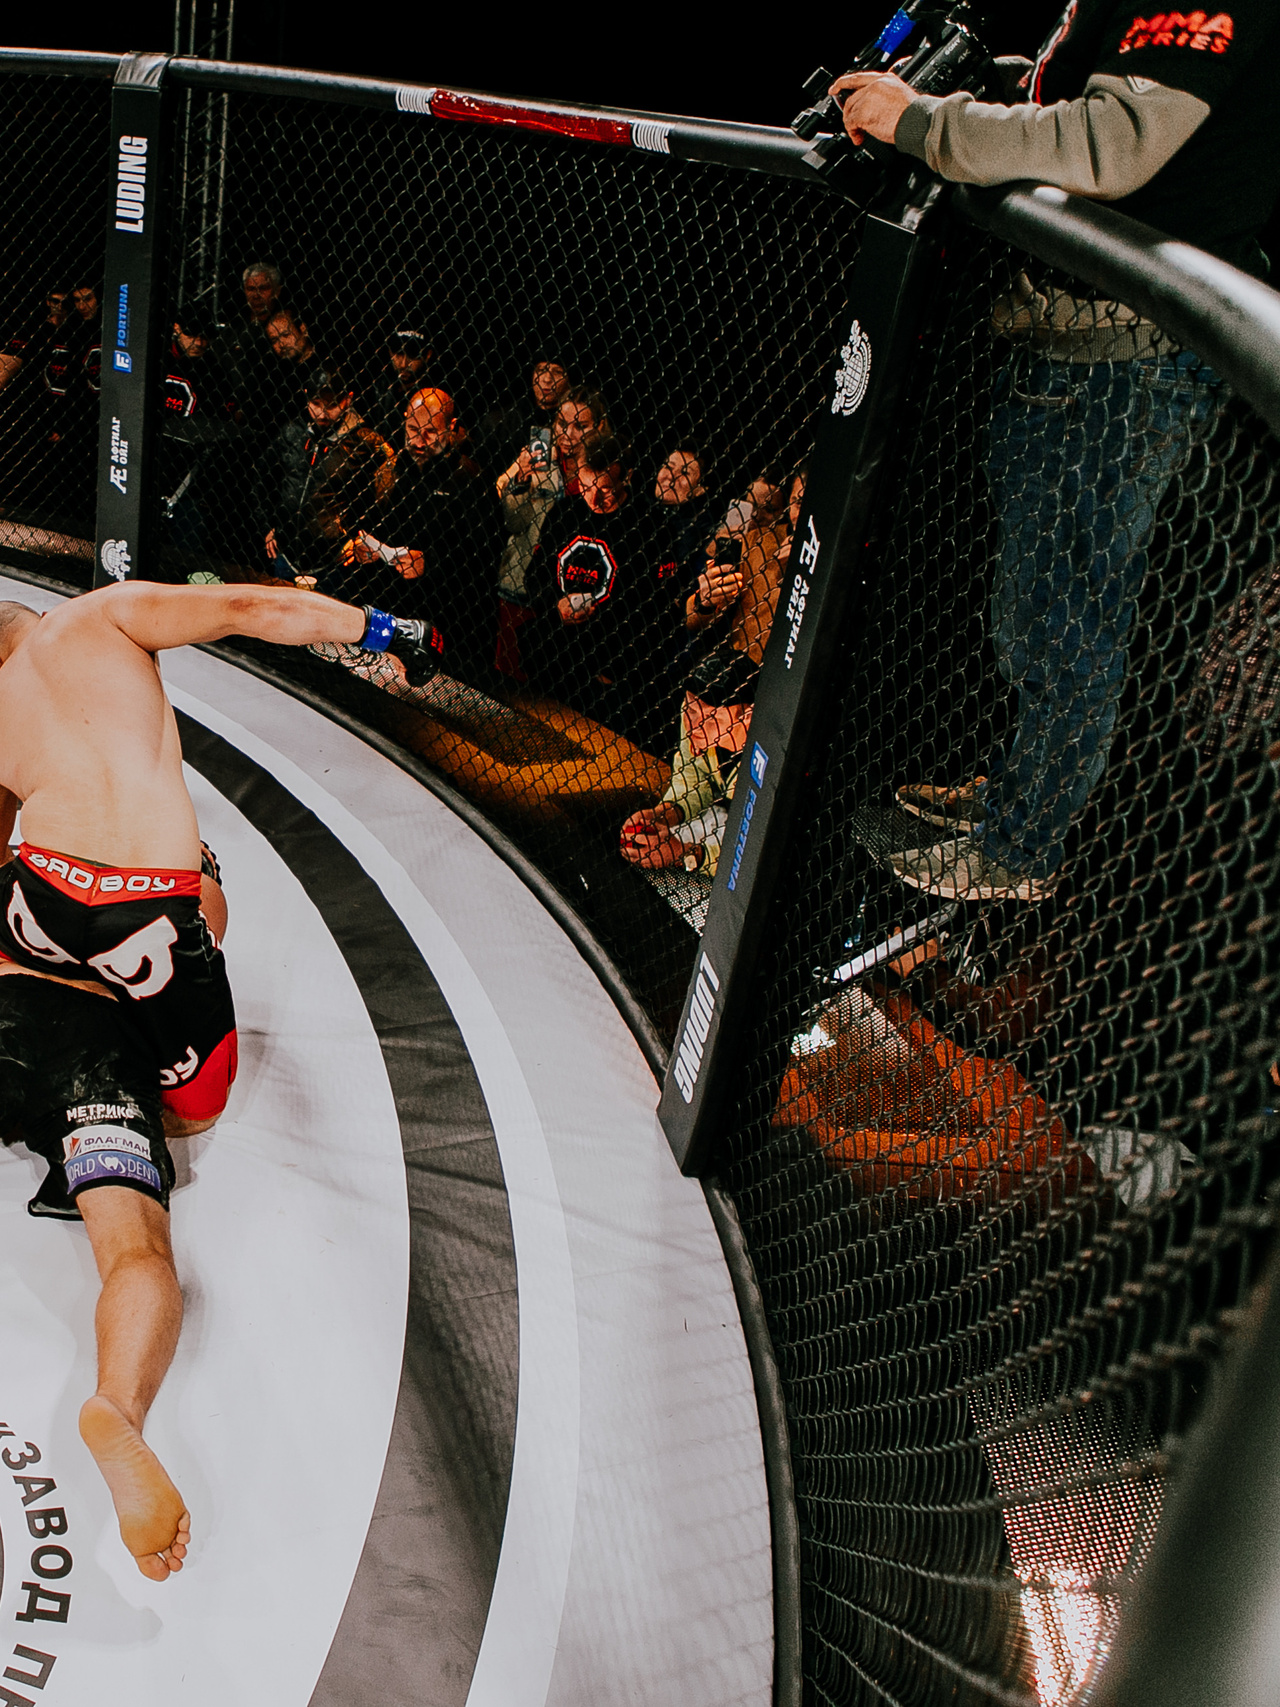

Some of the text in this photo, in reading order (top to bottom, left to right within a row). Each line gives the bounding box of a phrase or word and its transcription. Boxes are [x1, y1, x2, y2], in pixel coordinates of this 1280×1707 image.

[944, 37, 961, 56] SONY
[115, 135, 148, 234] LUDING
[117, 283, 129, 347] FORTUNA
[726, 788, 757, 891] FORTUNA
[28, 852, 176, 892] BAD BOY
[673, 951, 720, 1104] LUDING
[84, 1136, 150, 1157] ФЛАГМАН
